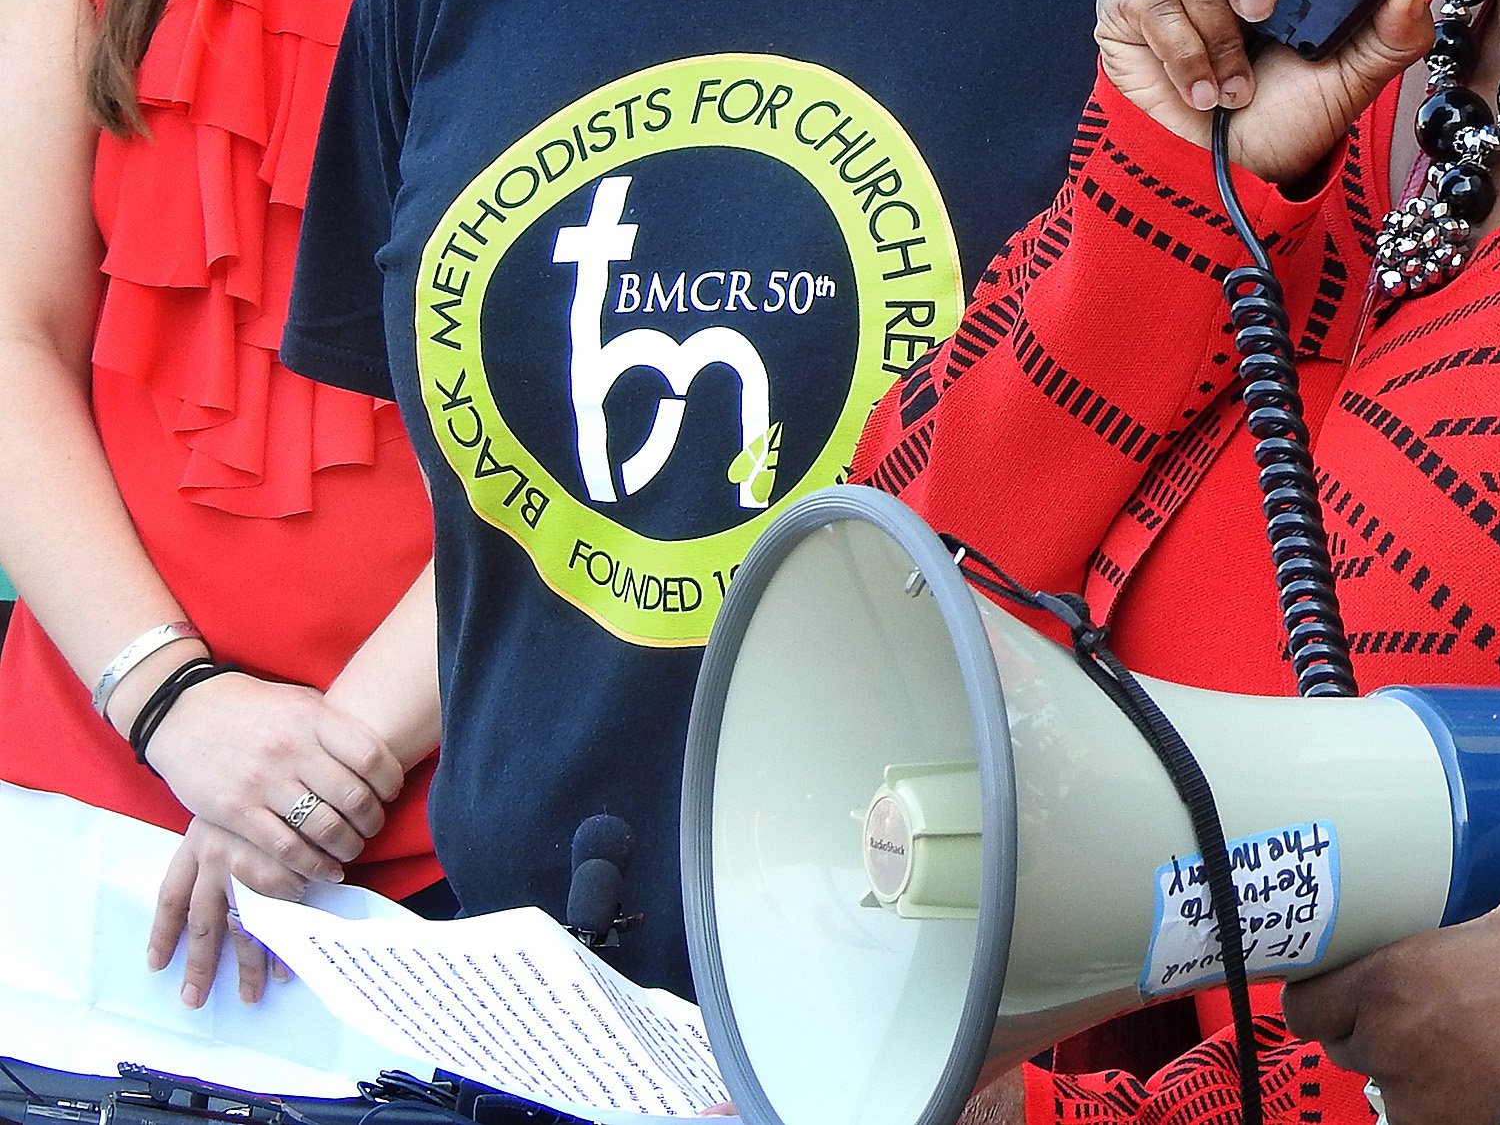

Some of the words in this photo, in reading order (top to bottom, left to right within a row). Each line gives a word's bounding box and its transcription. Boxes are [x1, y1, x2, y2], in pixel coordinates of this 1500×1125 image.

[691, 79, 792, 129] FOR
[430, 88, 671, 350] METHODISTS
[795, 101, 931, 280] CHURCH
[614, 270, 757, 314] BMCR
[762, 270, 837, 316] 50th
[881, 300, 936, 375] RE
[436, 370, 549, 529] BLACK
[569, 539, 702, 613] FOUNDED
[870, 837, 905, 855] RadioShack
